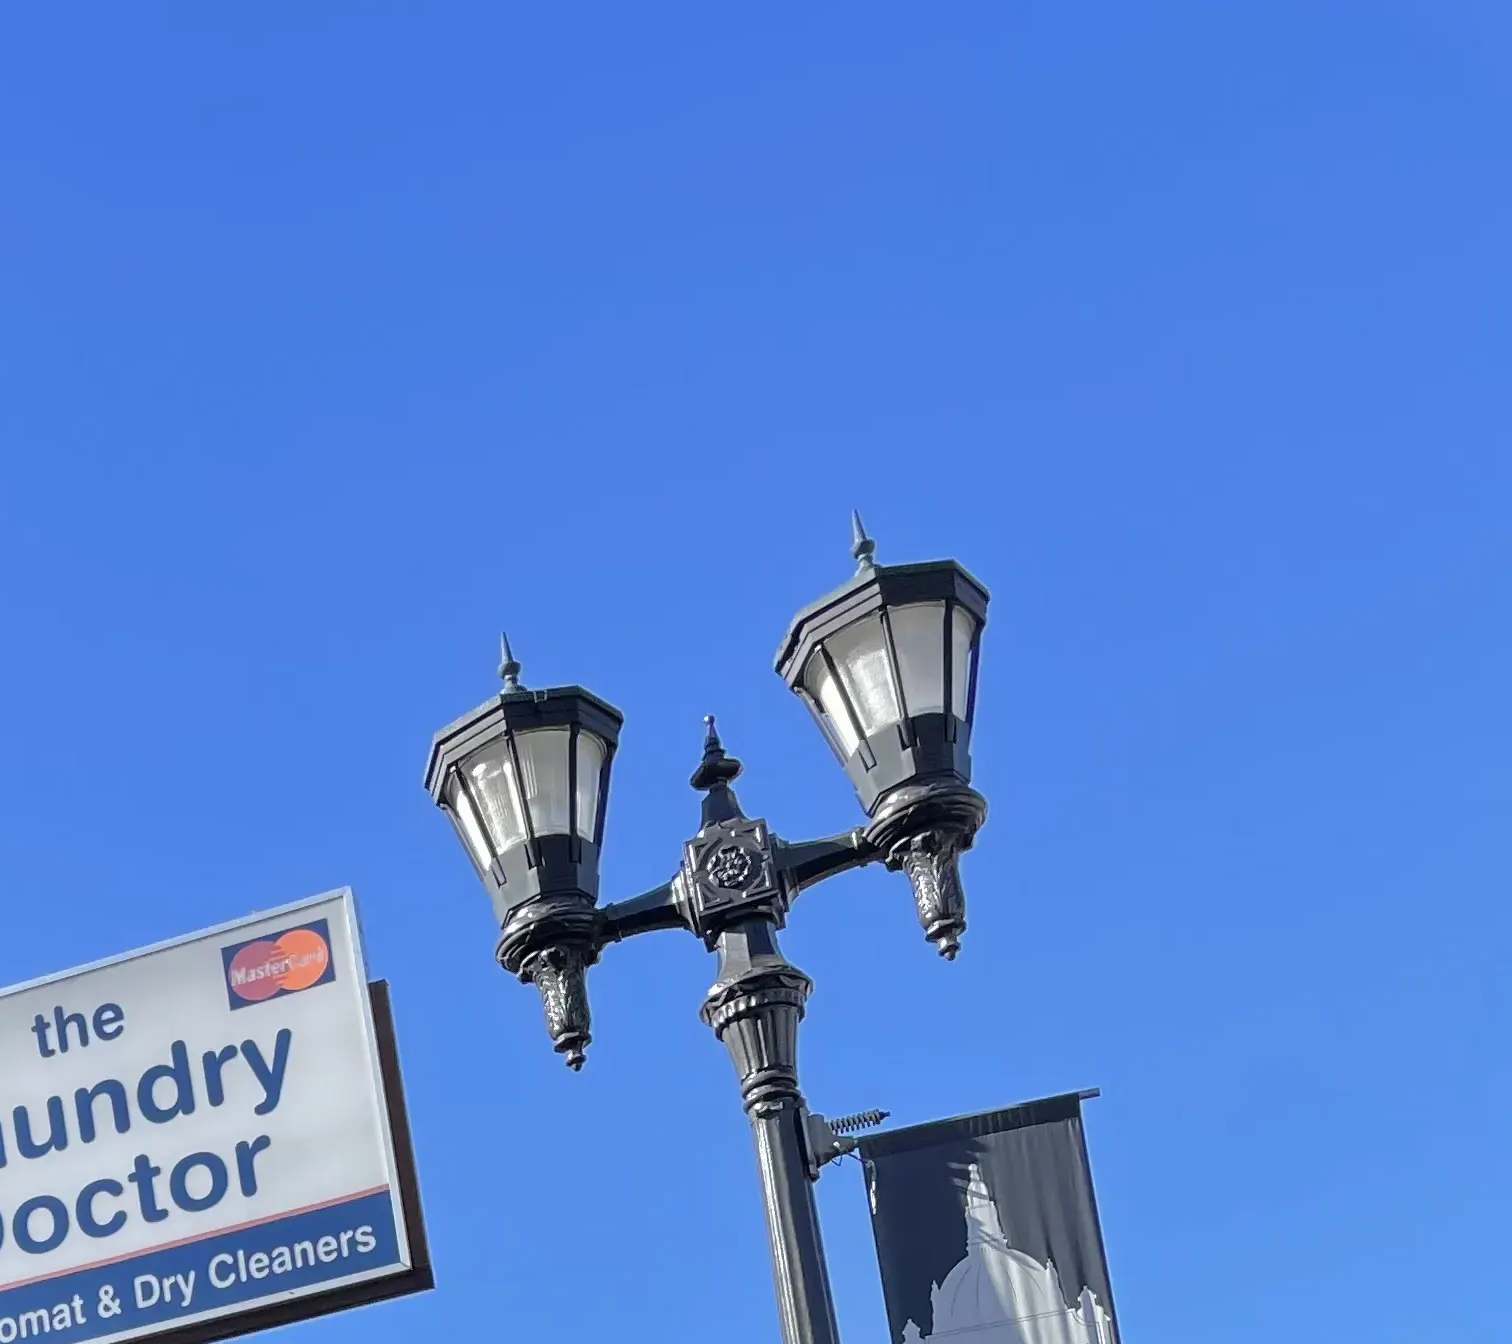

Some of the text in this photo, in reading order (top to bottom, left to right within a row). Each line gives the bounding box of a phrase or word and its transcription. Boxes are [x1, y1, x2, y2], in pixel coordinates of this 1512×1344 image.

[231, 944, 324, 987] MasterCard
[31, 1002, 125, 1058] the
[96, 1284, 122, 1319] &
[134, 1270, 196, 1309] Dry
[208, 1224, 376, 1290] Cleaners
